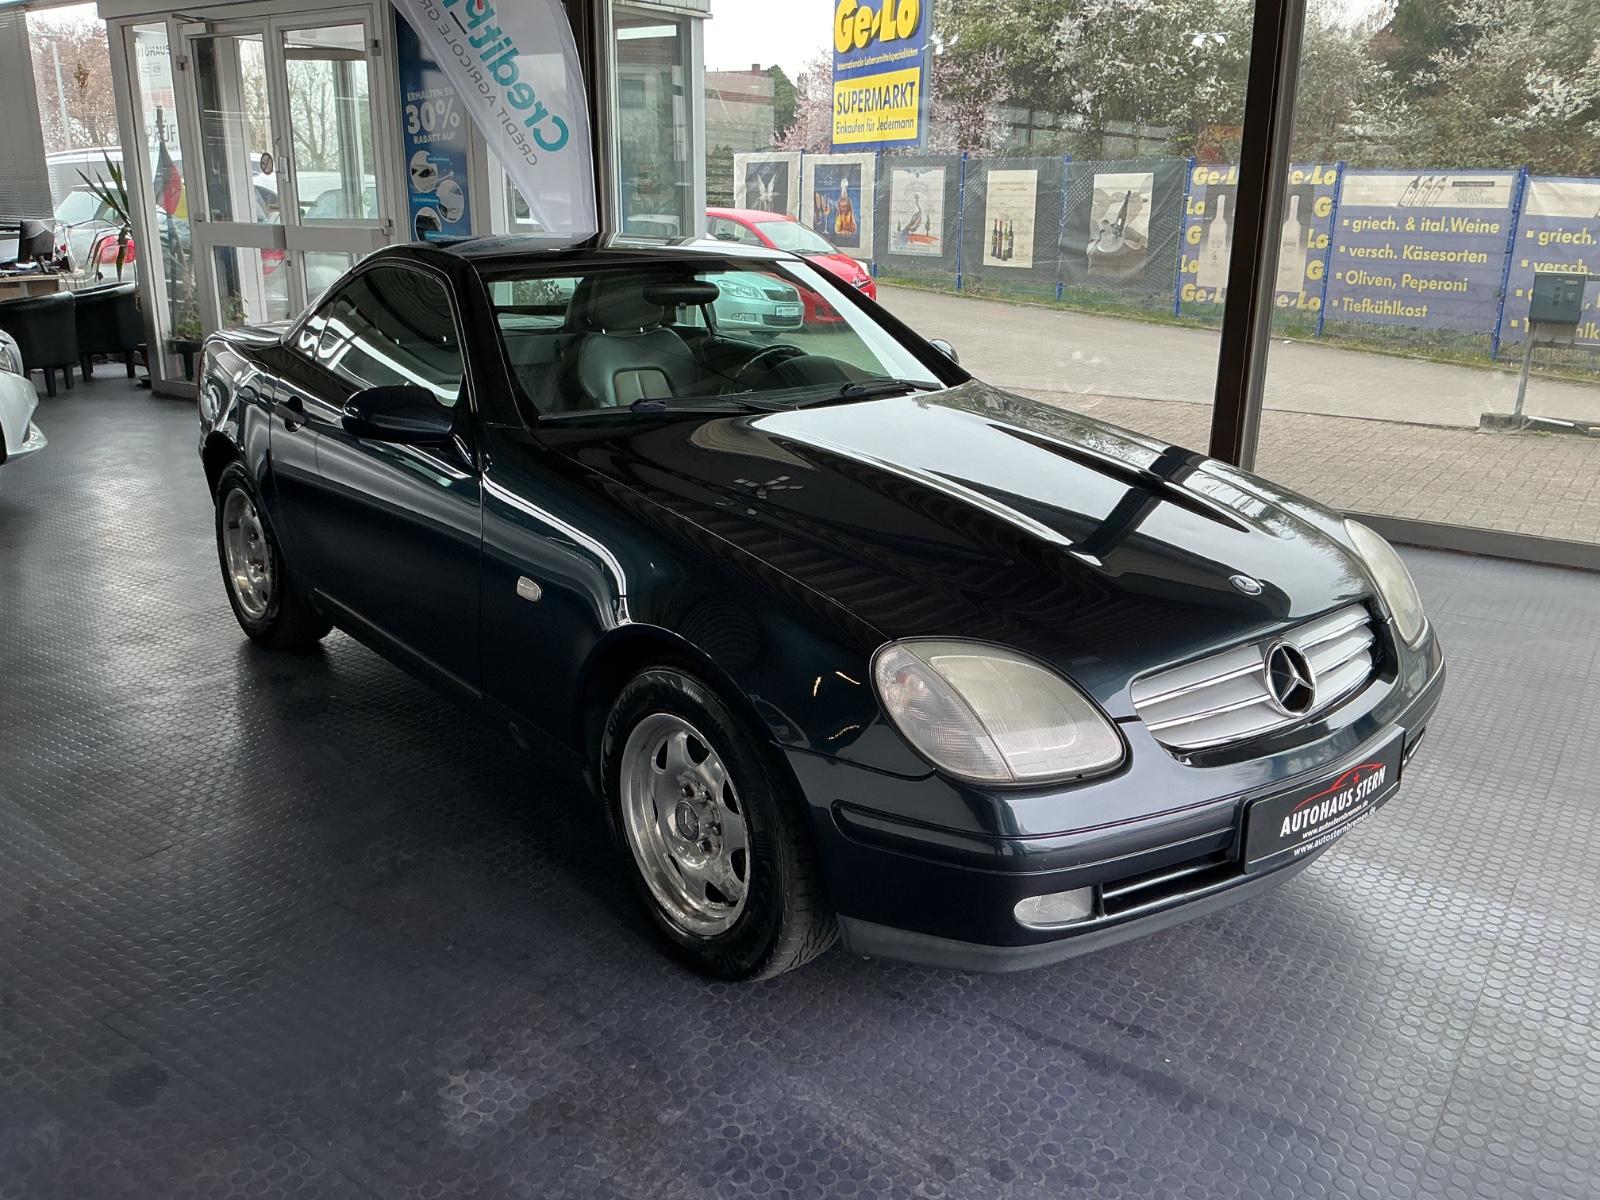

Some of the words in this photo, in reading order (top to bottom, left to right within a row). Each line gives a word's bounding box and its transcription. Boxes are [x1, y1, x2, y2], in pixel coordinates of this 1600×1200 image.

[836, 81, 917, 115] SUPERMARKT
[406, 97, 460, 135] 30%
[836, 118, 865, 135] Einkaufen
[866, 117, 875, 133] für
[876, 116, 915, 131] Jedermann
[1186, 196, 1206, 215] Lo
[1352, 216, 1400, 232] griech.
[1405, 219, 1416, 231] &
[1307, 228, 1329, 249] Lo
[1538, 227, 1598, 246] griech.
[1349, 244, 1398, 260] versch.
[1403, 245, 1488, 264] Käsesorten
[1346, 270, 1396, 290] Oliven,
[1401, 273, 1469, 294] Peperoni
[1343, 297, 1428, 318] Tiefkühlkost
[1279, 790, 1353, 838] AUTOHAUS
[1355, 765, 1387, 802] STERN
[1302, 800, 1369, 839] www.autosternbremen.de
[1293, 806, 1376, 857] www.autosternbremen.de
